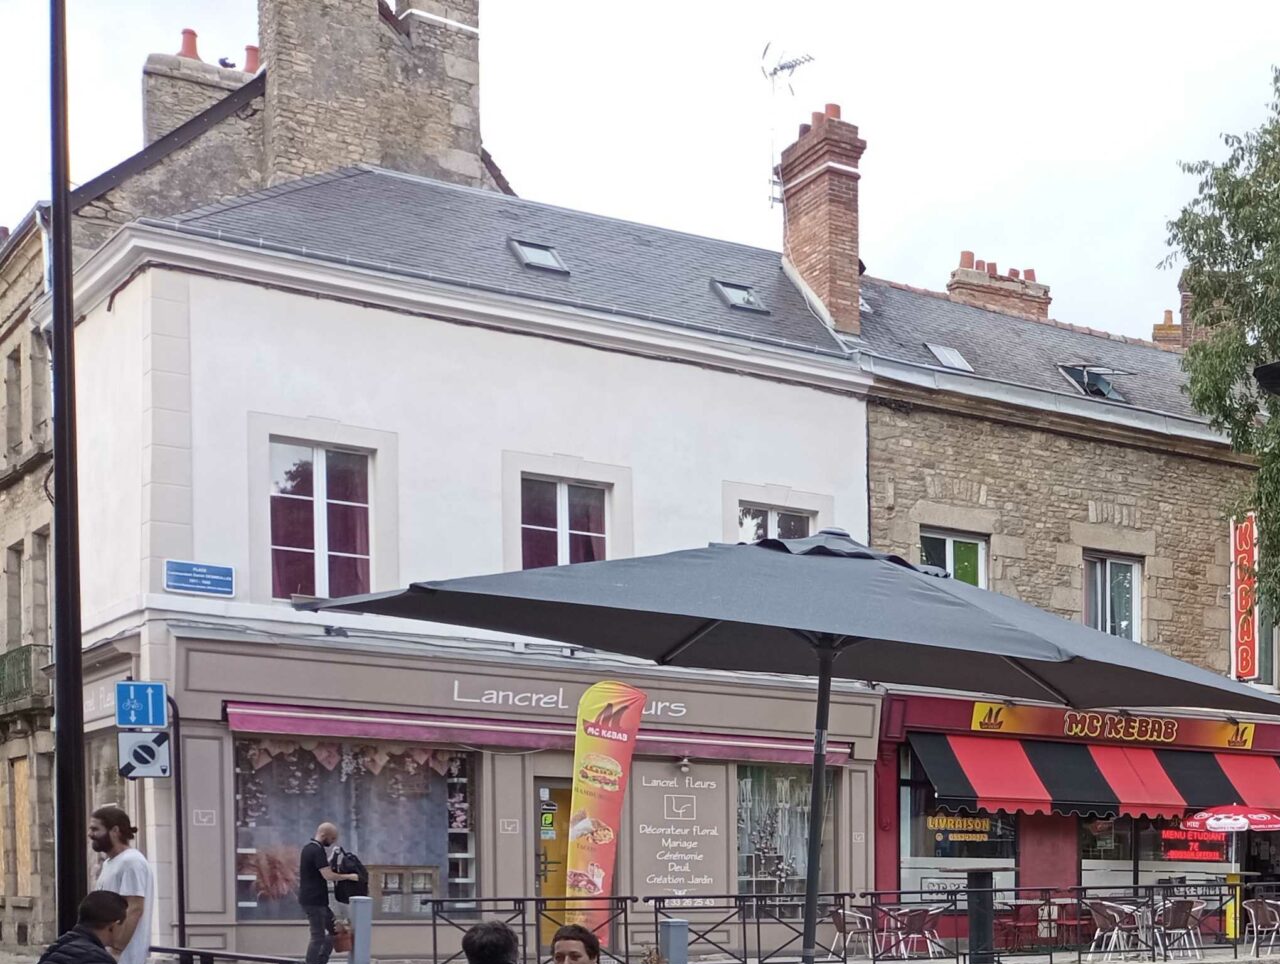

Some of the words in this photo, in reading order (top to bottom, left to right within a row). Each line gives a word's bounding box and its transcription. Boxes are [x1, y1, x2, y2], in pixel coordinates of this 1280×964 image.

[1236, 521, 1253, 674] KEBAB
[453, 680, 569, 709] Lancrel
[642, 699, 687, 717] urs
[1064, 710, 1101, 737] MC
[1104, 711, 1179, 743] KEBAB
[642, 775, 679, 788] Lancrel
[685, 776, 717, 789] fleurs
[639, 824, 690, 836] Décorateur
[692, 825, 720, 836] floral
[927, 815, 991, 832] LIVRAISON
[1162, 830, 1186, 840] MENU
[661, 837, 698, 850] Mariage
[656, 850, 704, 861] Cérémonie
[668, 861, 691, 872] Deuil
[646, 874, 685, 884] Création
[687, 874, 713, 884] Jardin
